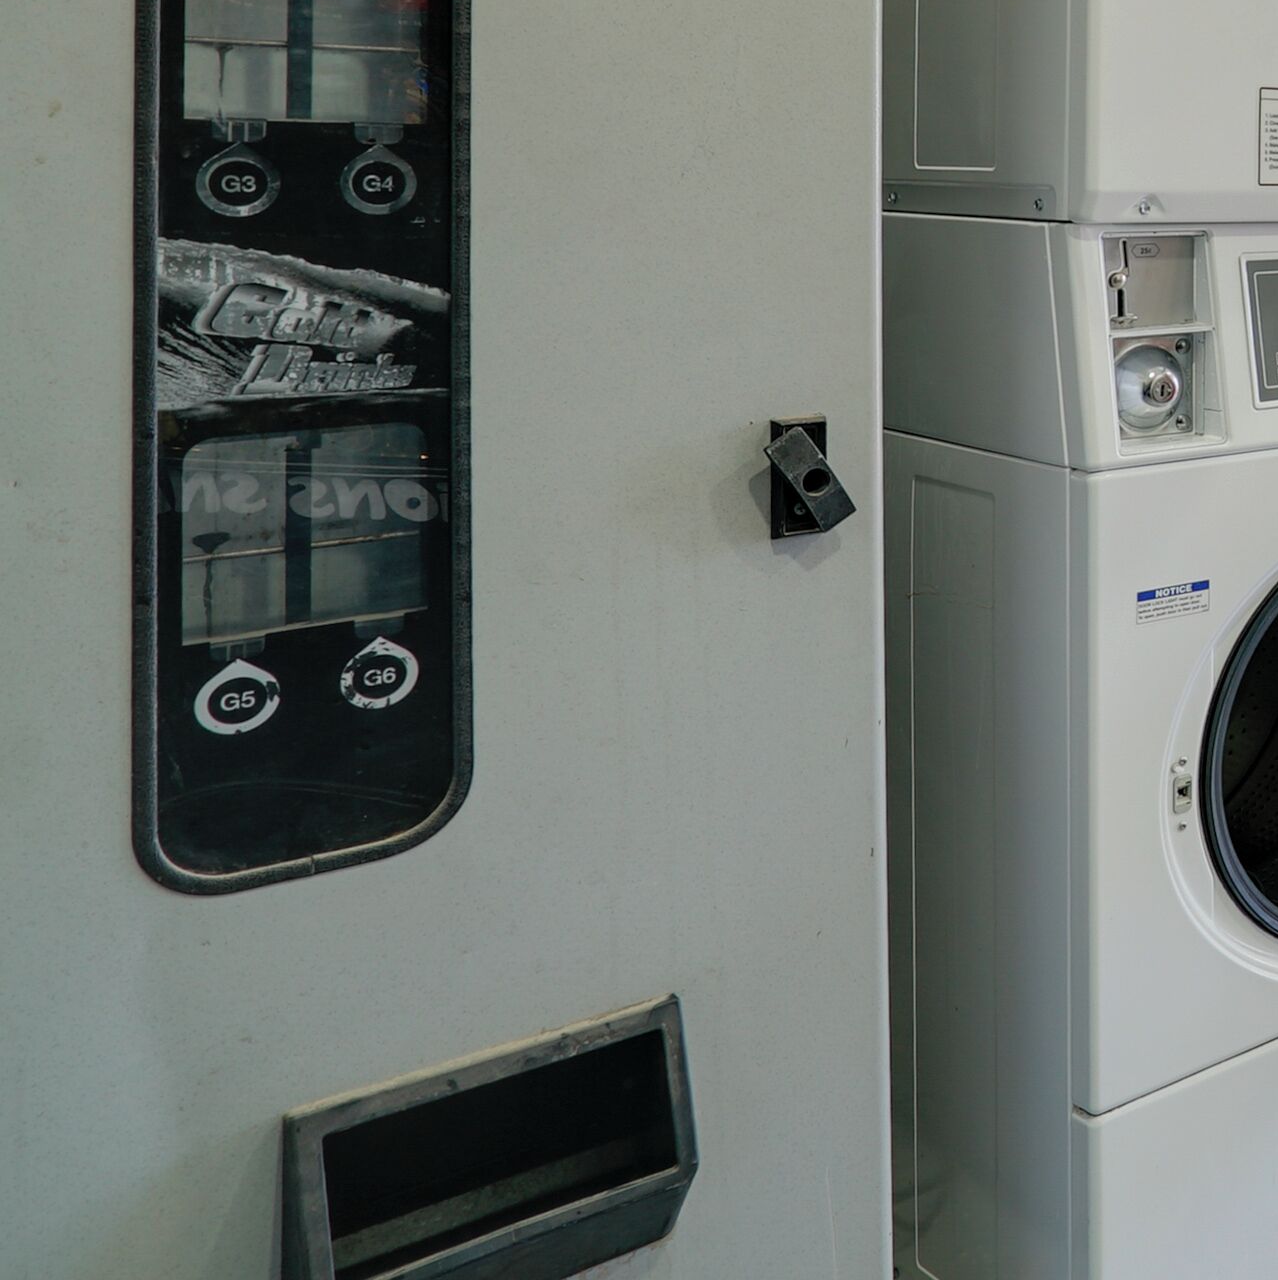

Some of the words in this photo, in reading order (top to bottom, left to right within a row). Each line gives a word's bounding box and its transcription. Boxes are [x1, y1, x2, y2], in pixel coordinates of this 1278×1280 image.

[221, 175, 257, 193] G3
[363, 175, 395, 193] G4
[1155, 584, 1193, 598] NOTICE
[363, 667, 397, 687] G6
[220, 691, 256, 712] G5
